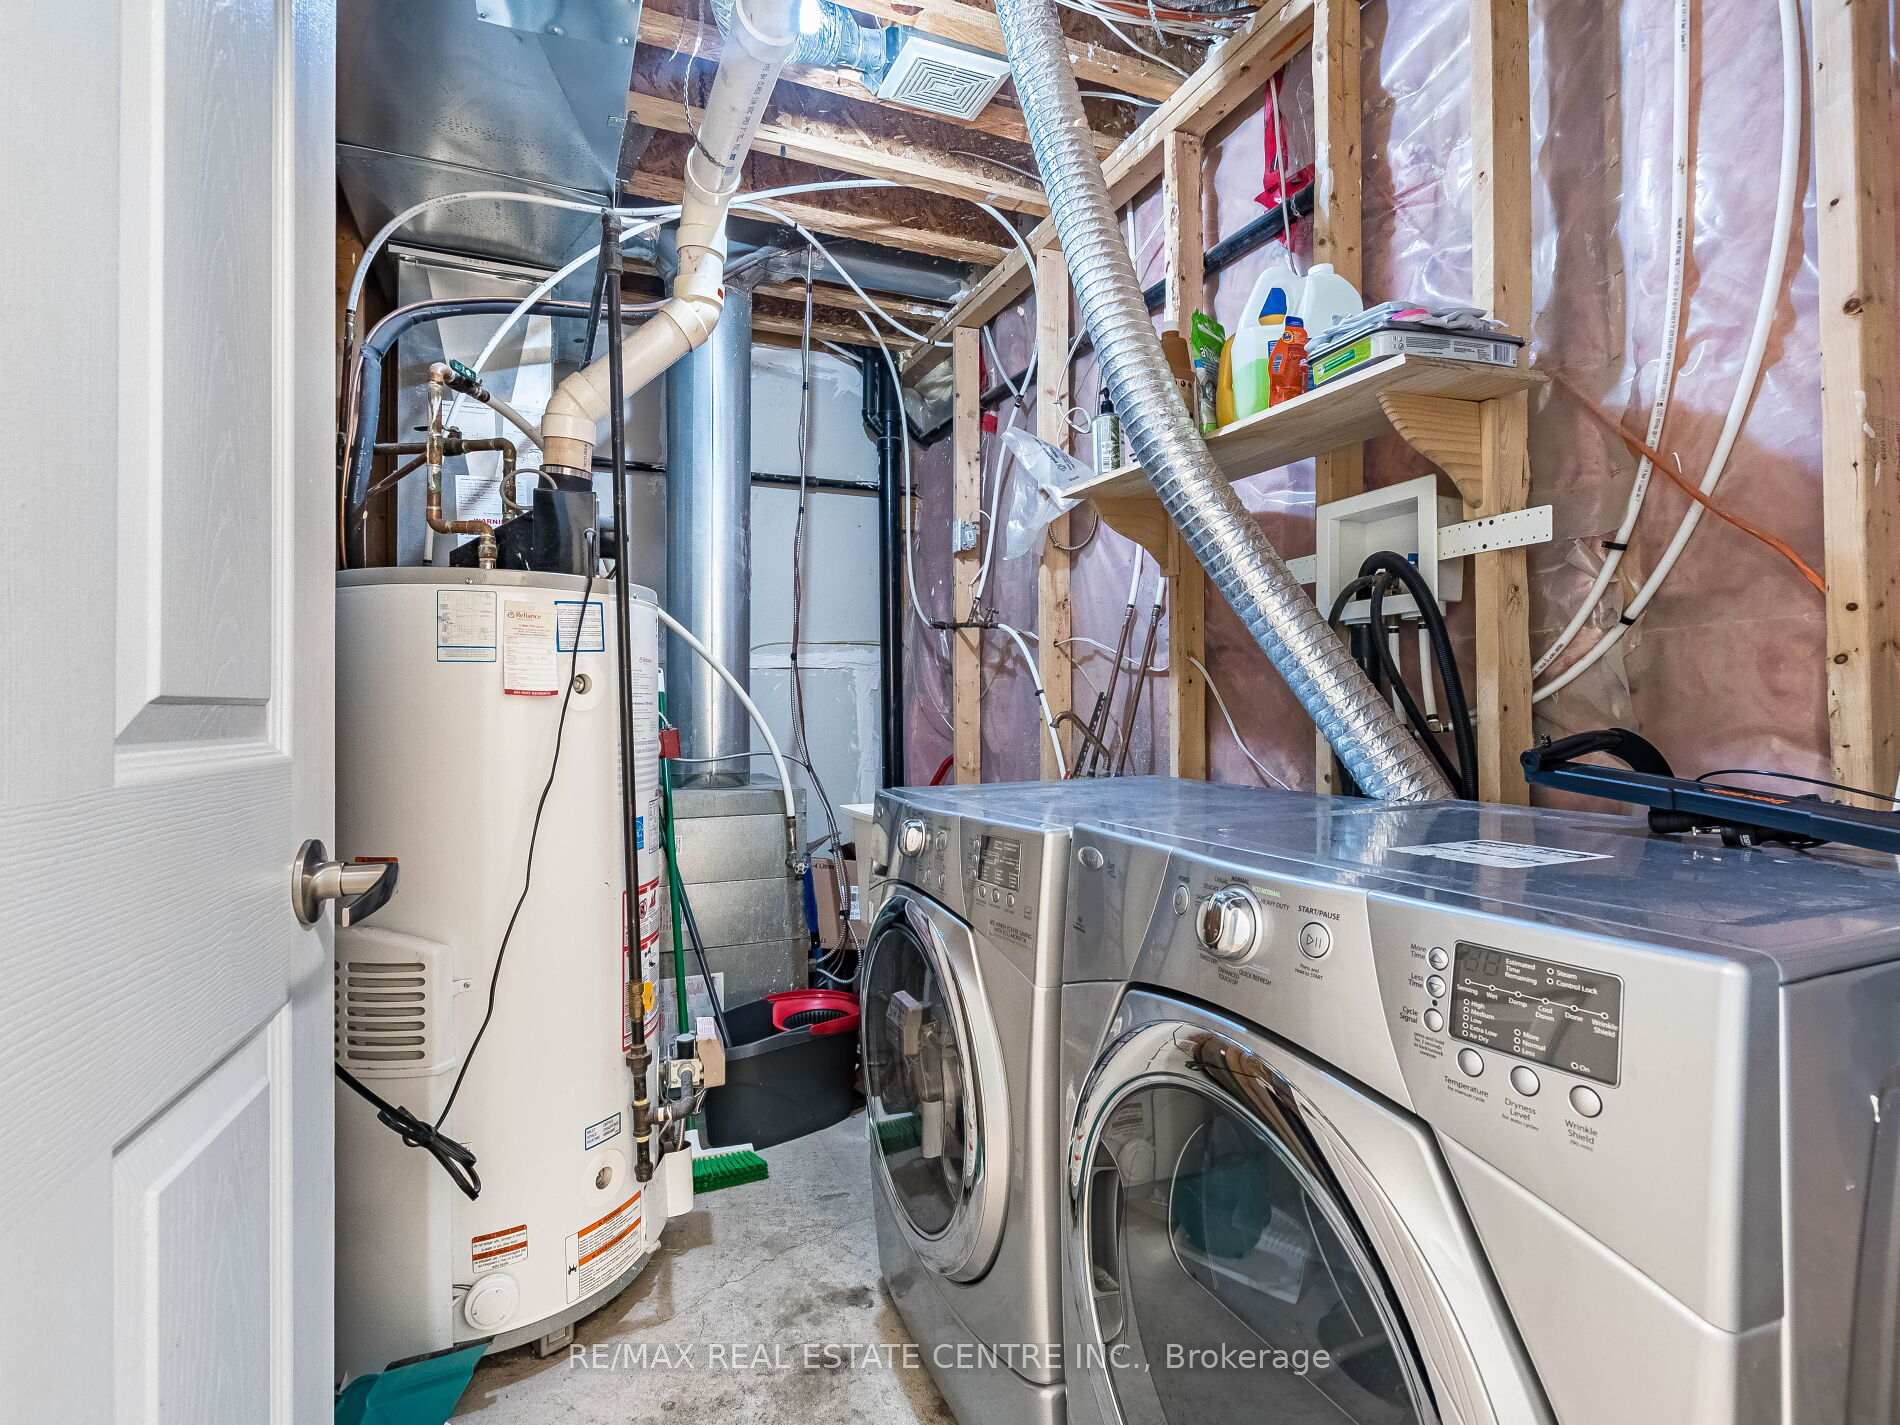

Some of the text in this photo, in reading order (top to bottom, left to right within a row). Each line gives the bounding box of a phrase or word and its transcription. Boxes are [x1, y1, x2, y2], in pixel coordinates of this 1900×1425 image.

[1276, 902, 1290, 911] DUTY
[1297, 905, 1341, 921] START/PAUSE
[1410, 943, 1427, 952] More
[1411, 951, 1426, 959] Time
[1505, 958, 1536, 970] Estimated
[1505, 965, 1521, 973] Time
[1239, 969, 1252, 979] QUICK
[1310, 971, 1323, 981] START
[1411, 972, 1424, 981] Less
[1504, 971, 1538, 986] Remaining
[1408, 979, 1424, 988] Time
[1556, 980, 1598, 995] Control Lock
[1486, 991, 1498, 1000] Wet
[1508, 997, 1528, 1008] Damp
[1402, 1006, 1418, 1016] Cycle
[1470, 1001, 1485, 1010] High
[1537, 1005, 1553, 1014] Cool
[1399, 1013, 1418, 1024] Signal
[1470, 1009, 1495, 1020] Medium
[1535, 1011, 1555, 1022] Down
[1564, 1012, 1584, 1022] Done
[1470, 1017, 1482, 1025] Low
[1591, 1018, 1619, 1031] Wrinkle
[1469, 1024, 1498, 1037] Extra Low
[1593, 1026, 1616, 1038] Shield
[1478, 1035, 1489, 1044] Dry
[1522, 1039, 1546, 1051] Normal
[1444, 1075, 1489, 1098] Temperature
[1504, 1097, 1536, 1115] Dryness
[1510, 1107, 1531, 1120] Level
[1565, 1119, 1598, 1136] Wrinkle
[1567, 1129, 1595, 1145] Shield
